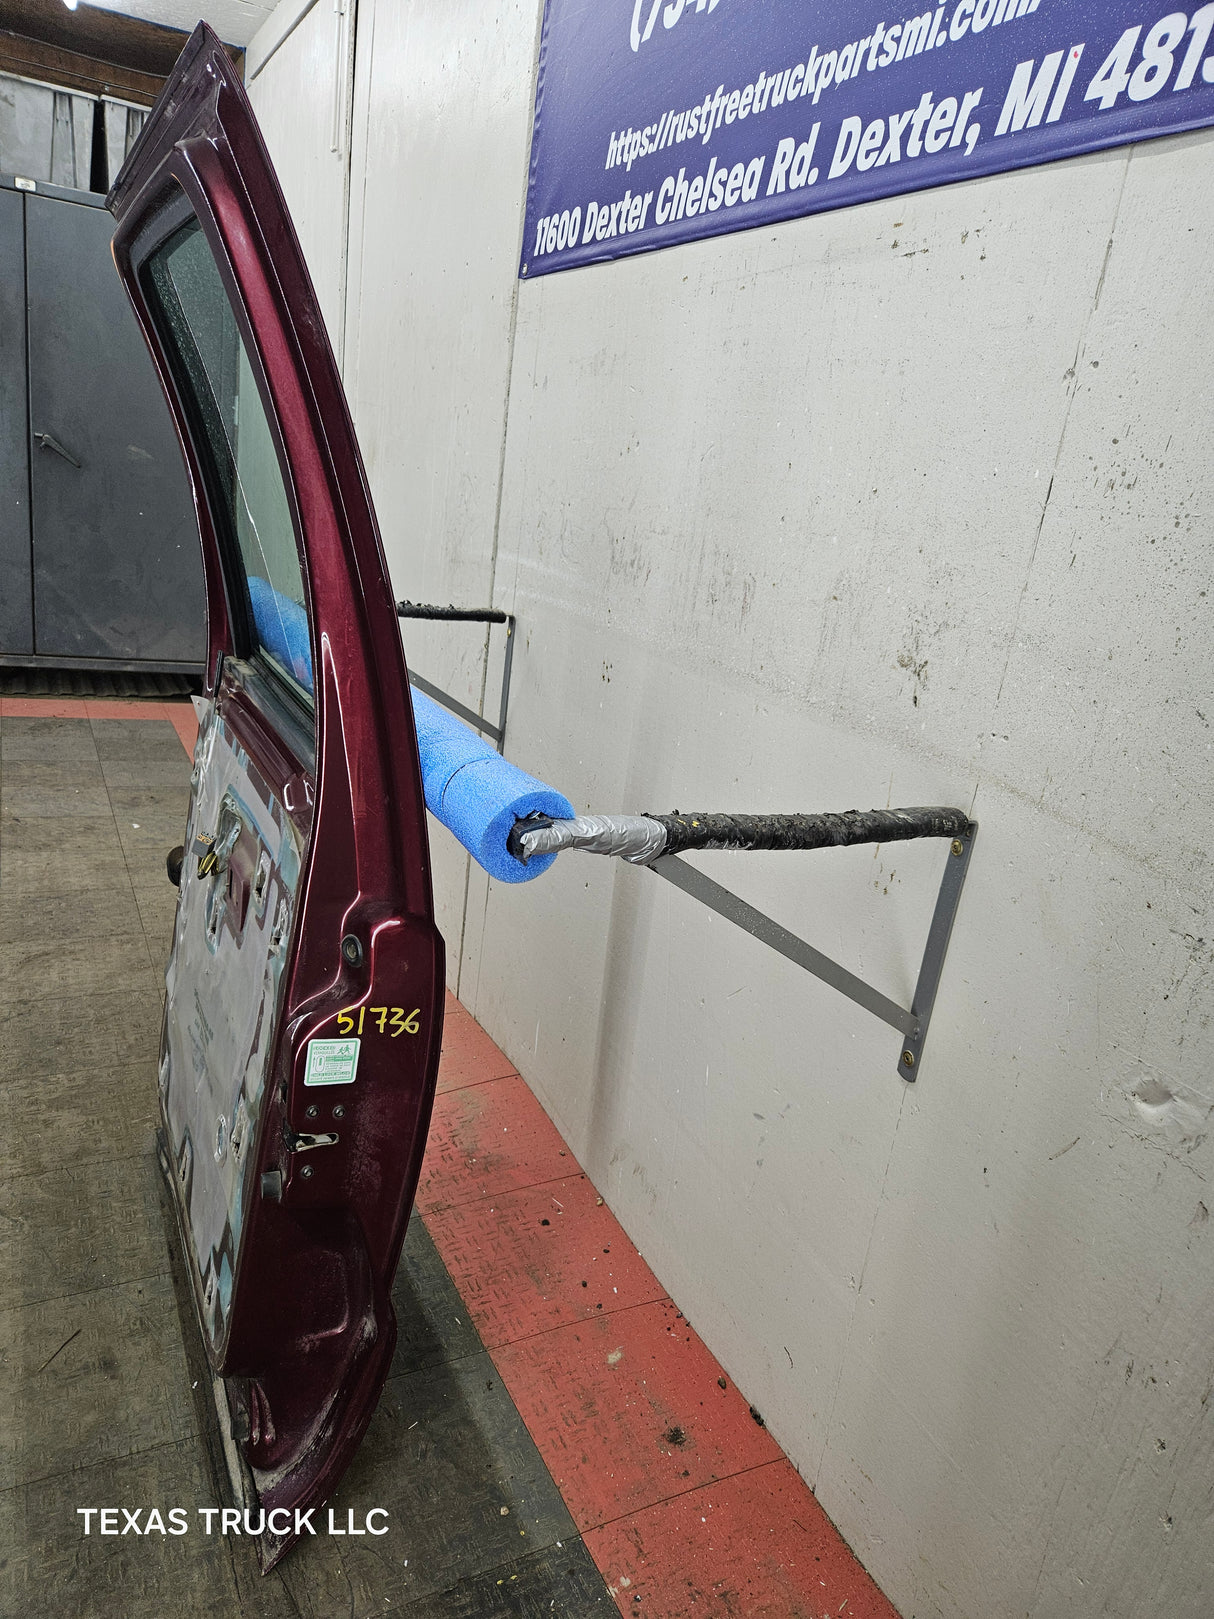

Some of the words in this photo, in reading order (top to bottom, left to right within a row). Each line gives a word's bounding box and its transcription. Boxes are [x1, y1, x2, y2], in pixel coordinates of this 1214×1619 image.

[533, 206, 582, 256] 11600
[582, 190, 653, 244] Dexter
[655, 156, 766, 225] Chelsea
[766, 121, 821, 196] Rd.
[827, 87, 984, 180] Dexter,
[994, 43, 1086, 136] MI
[1084, 2, 1214, 110] 481
[337, 1006, 420, 1037] 51736
